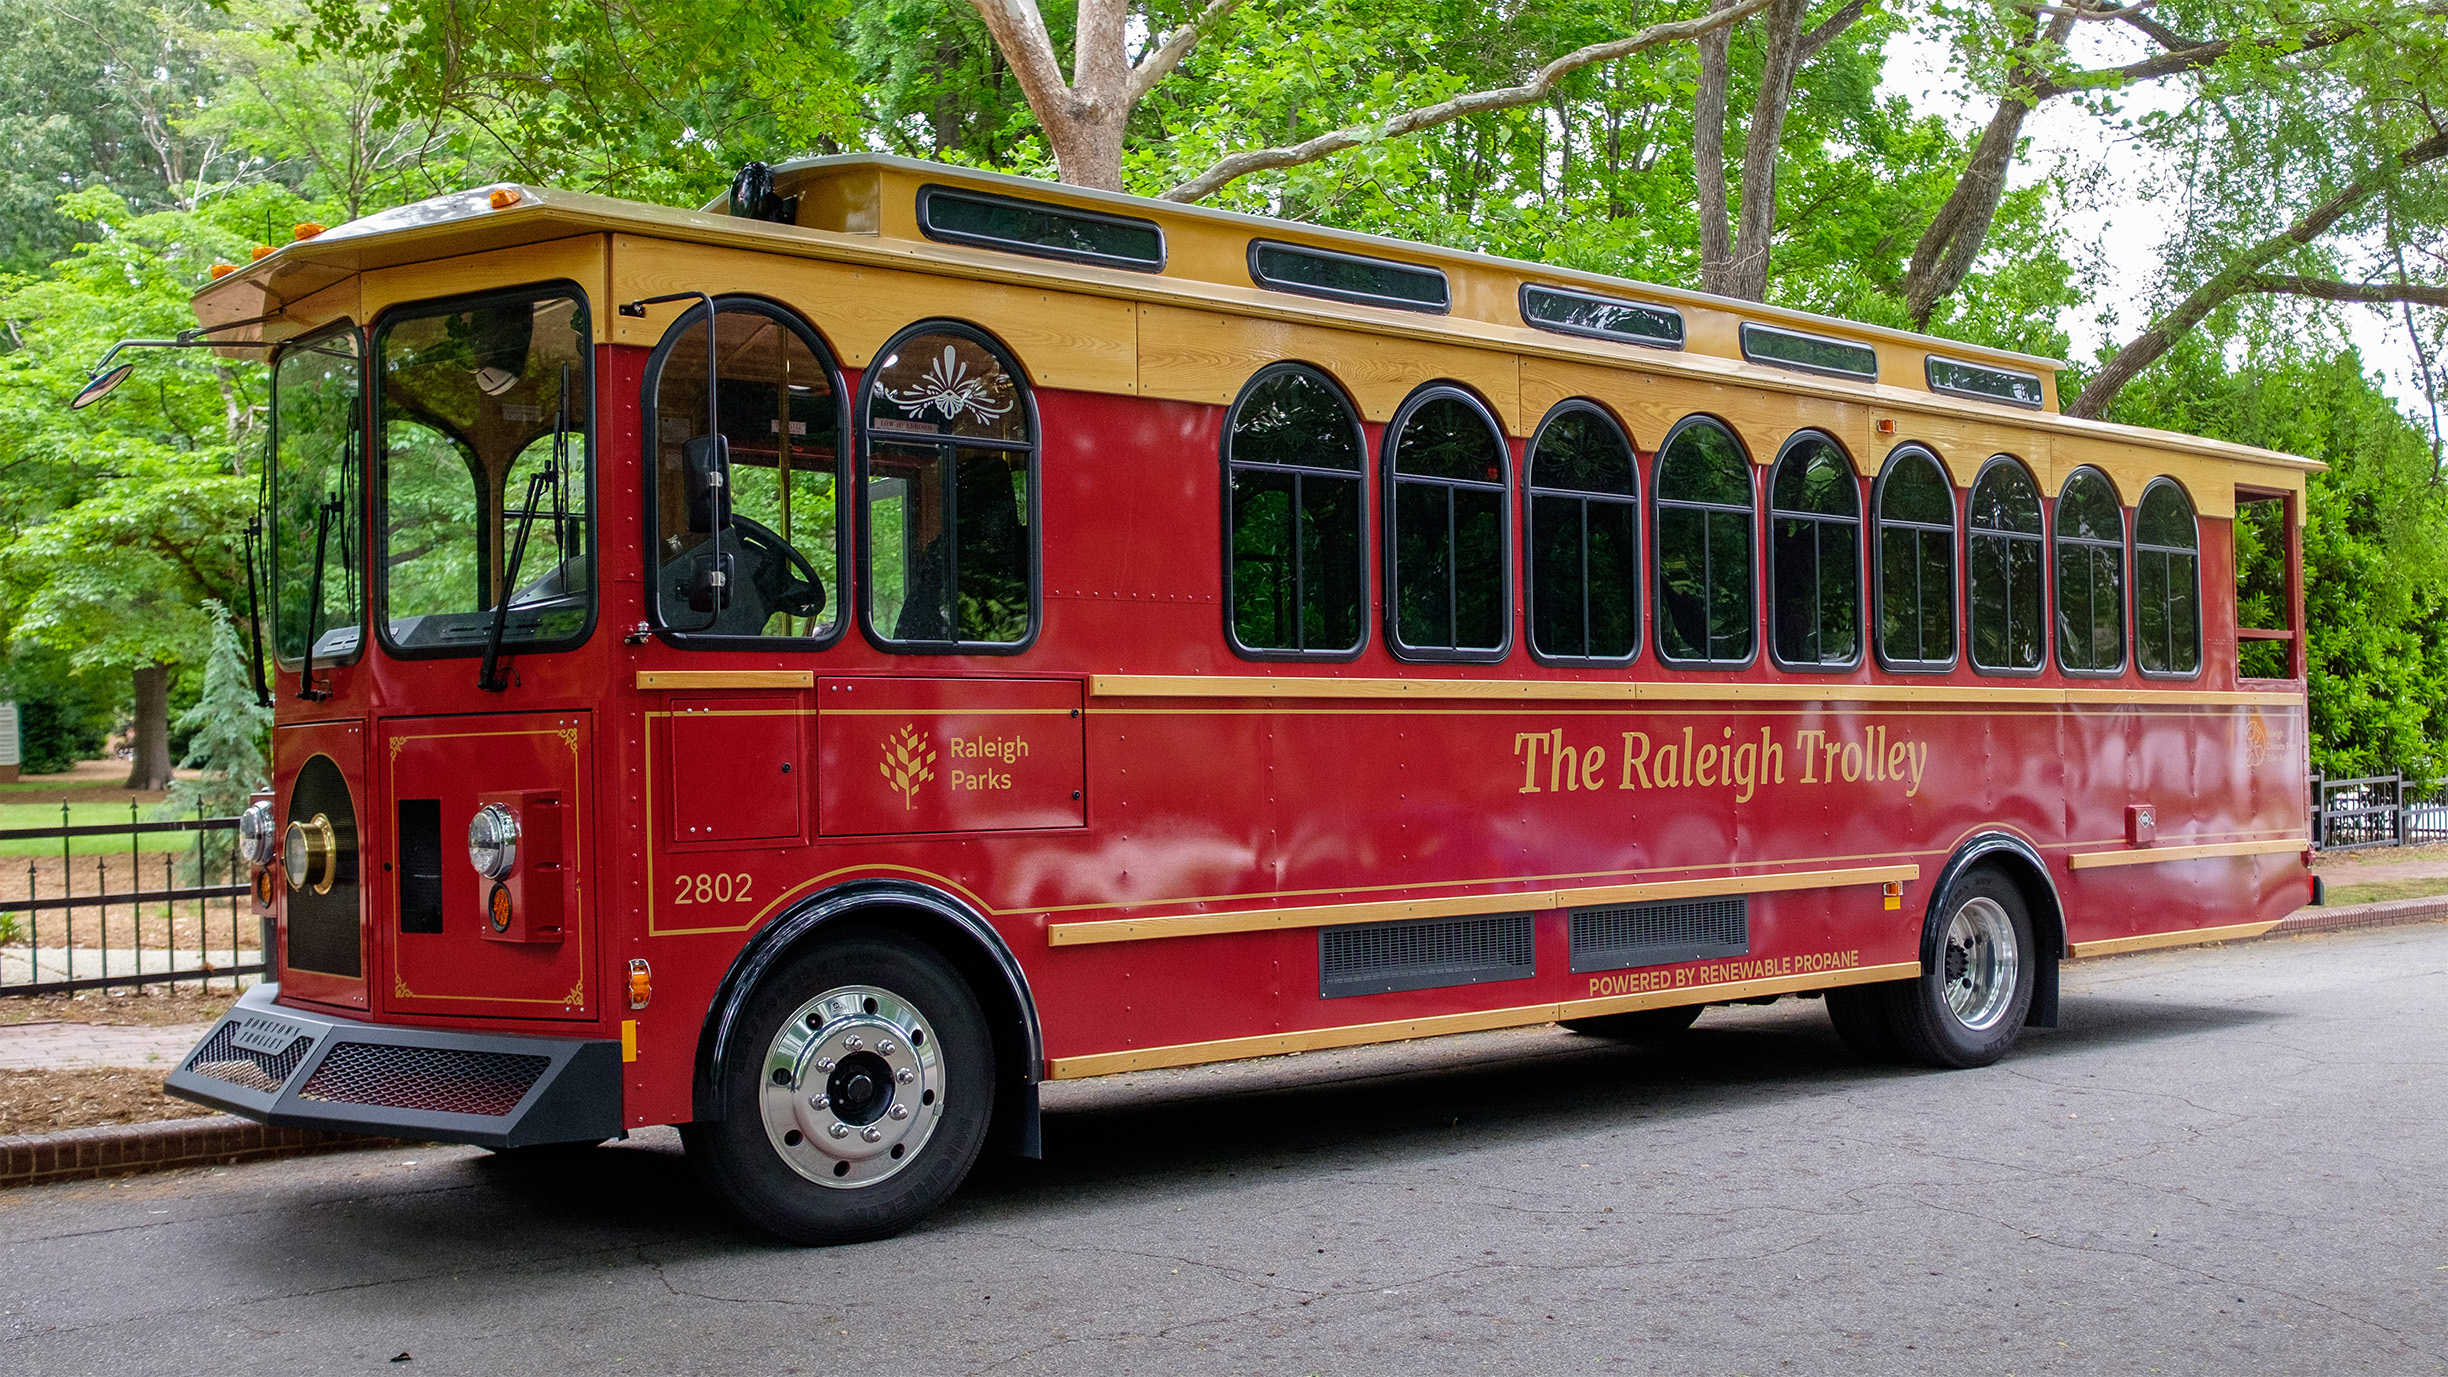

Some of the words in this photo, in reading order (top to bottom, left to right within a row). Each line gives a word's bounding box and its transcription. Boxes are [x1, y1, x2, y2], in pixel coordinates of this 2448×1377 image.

[951, 735, 1029, 764] Raleigh
[1514, 728, 1605, 793] The
[1619, 726, 1785, 803] Raleigh
[1797, 725, 1928, 797] Trolley
[951, 768, 1012, 790] Parks
[675, 873, 753, 905] 2802
[1589, 970, 1671, 997] POWERED
[1675, 967, 1696, 987] BY
[1700, 957, 1791, 984] RENEWABLE
[1794, 950, 1859, 973] PROPANE
[239, 1031, 286, 1050] TROLLEY
[244, 1017, 302, 1038] HOMETOWN
[844, 1115, 977, 1221] MICHELIN
